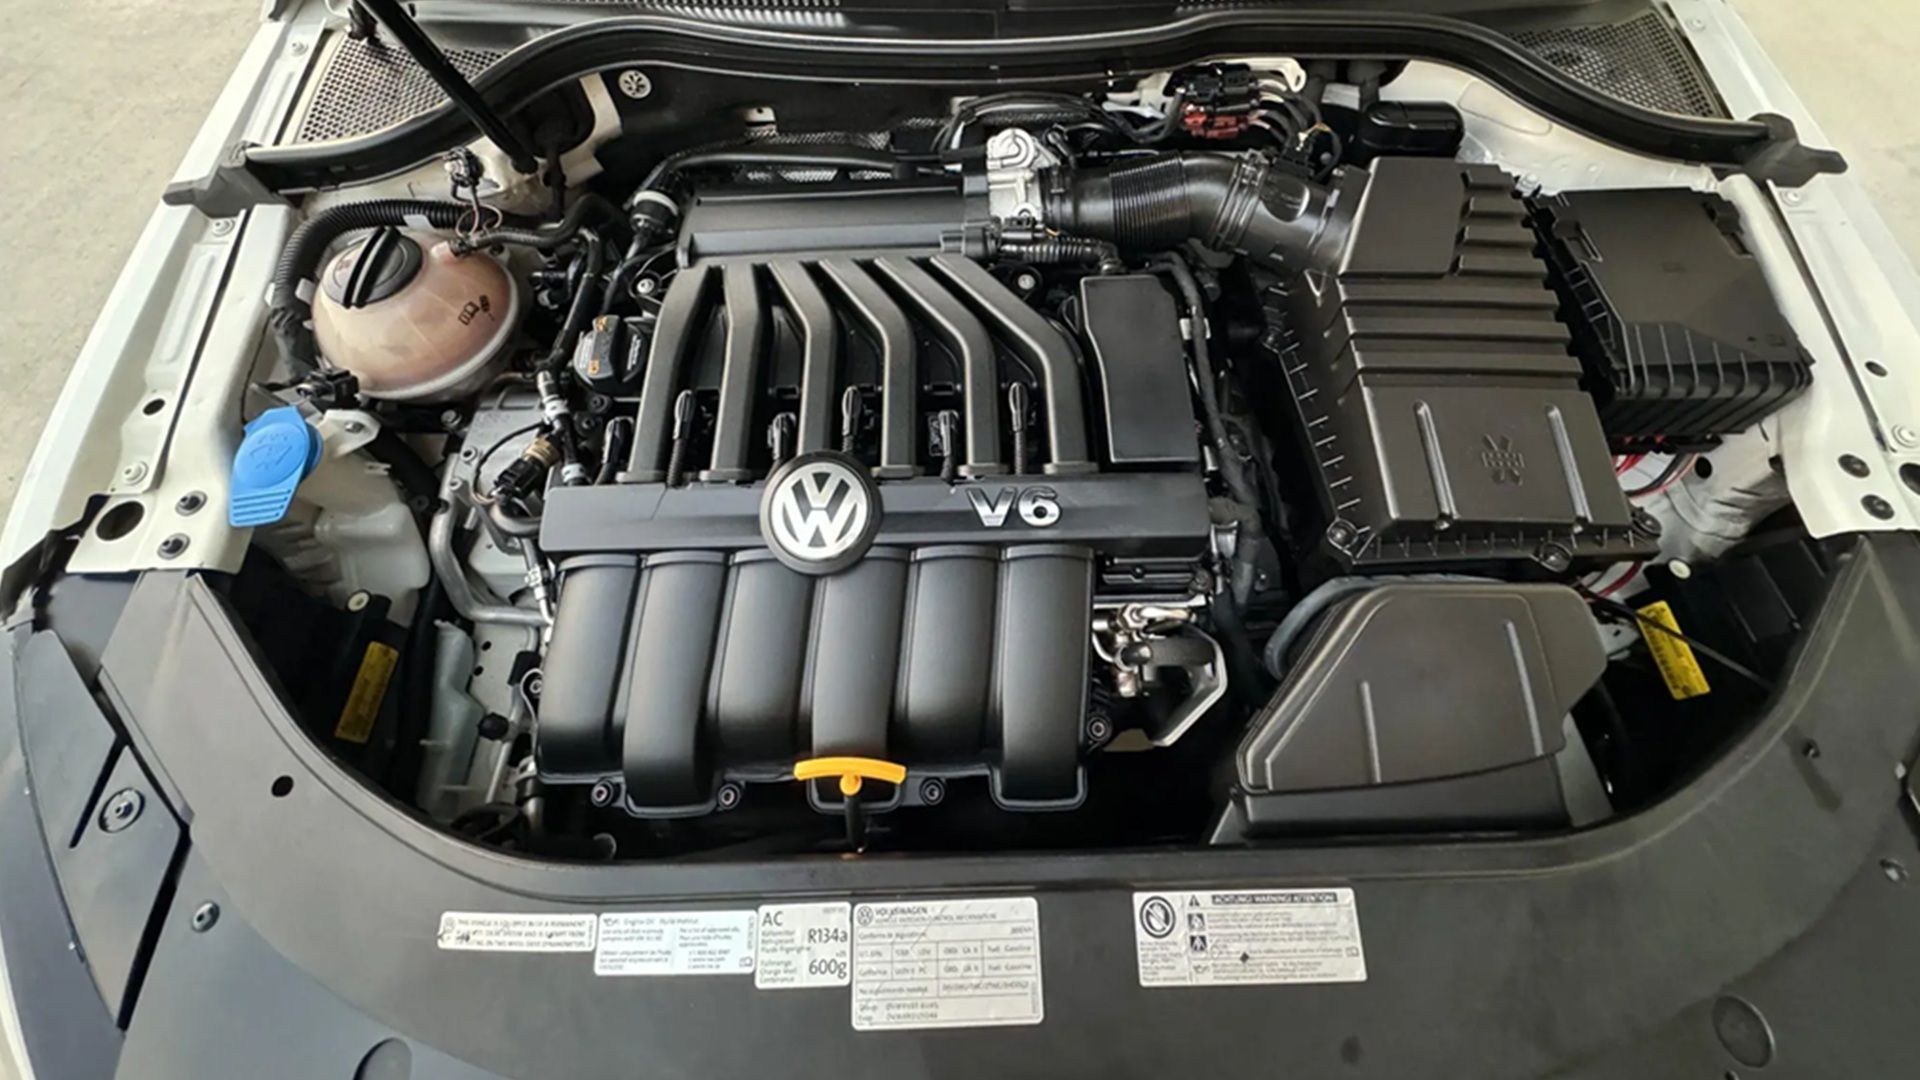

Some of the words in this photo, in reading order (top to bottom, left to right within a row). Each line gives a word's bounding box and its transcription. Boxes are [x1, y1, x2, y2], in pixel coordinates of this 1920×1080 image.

[967, 486, 1061, 528] V6
[762, 911, 783, 926] AC
[875, 906, 928, 916] VOLKSWAGEN
[808, 928, 848, 944] R134a
[809, 958, 847, 980] 600g
